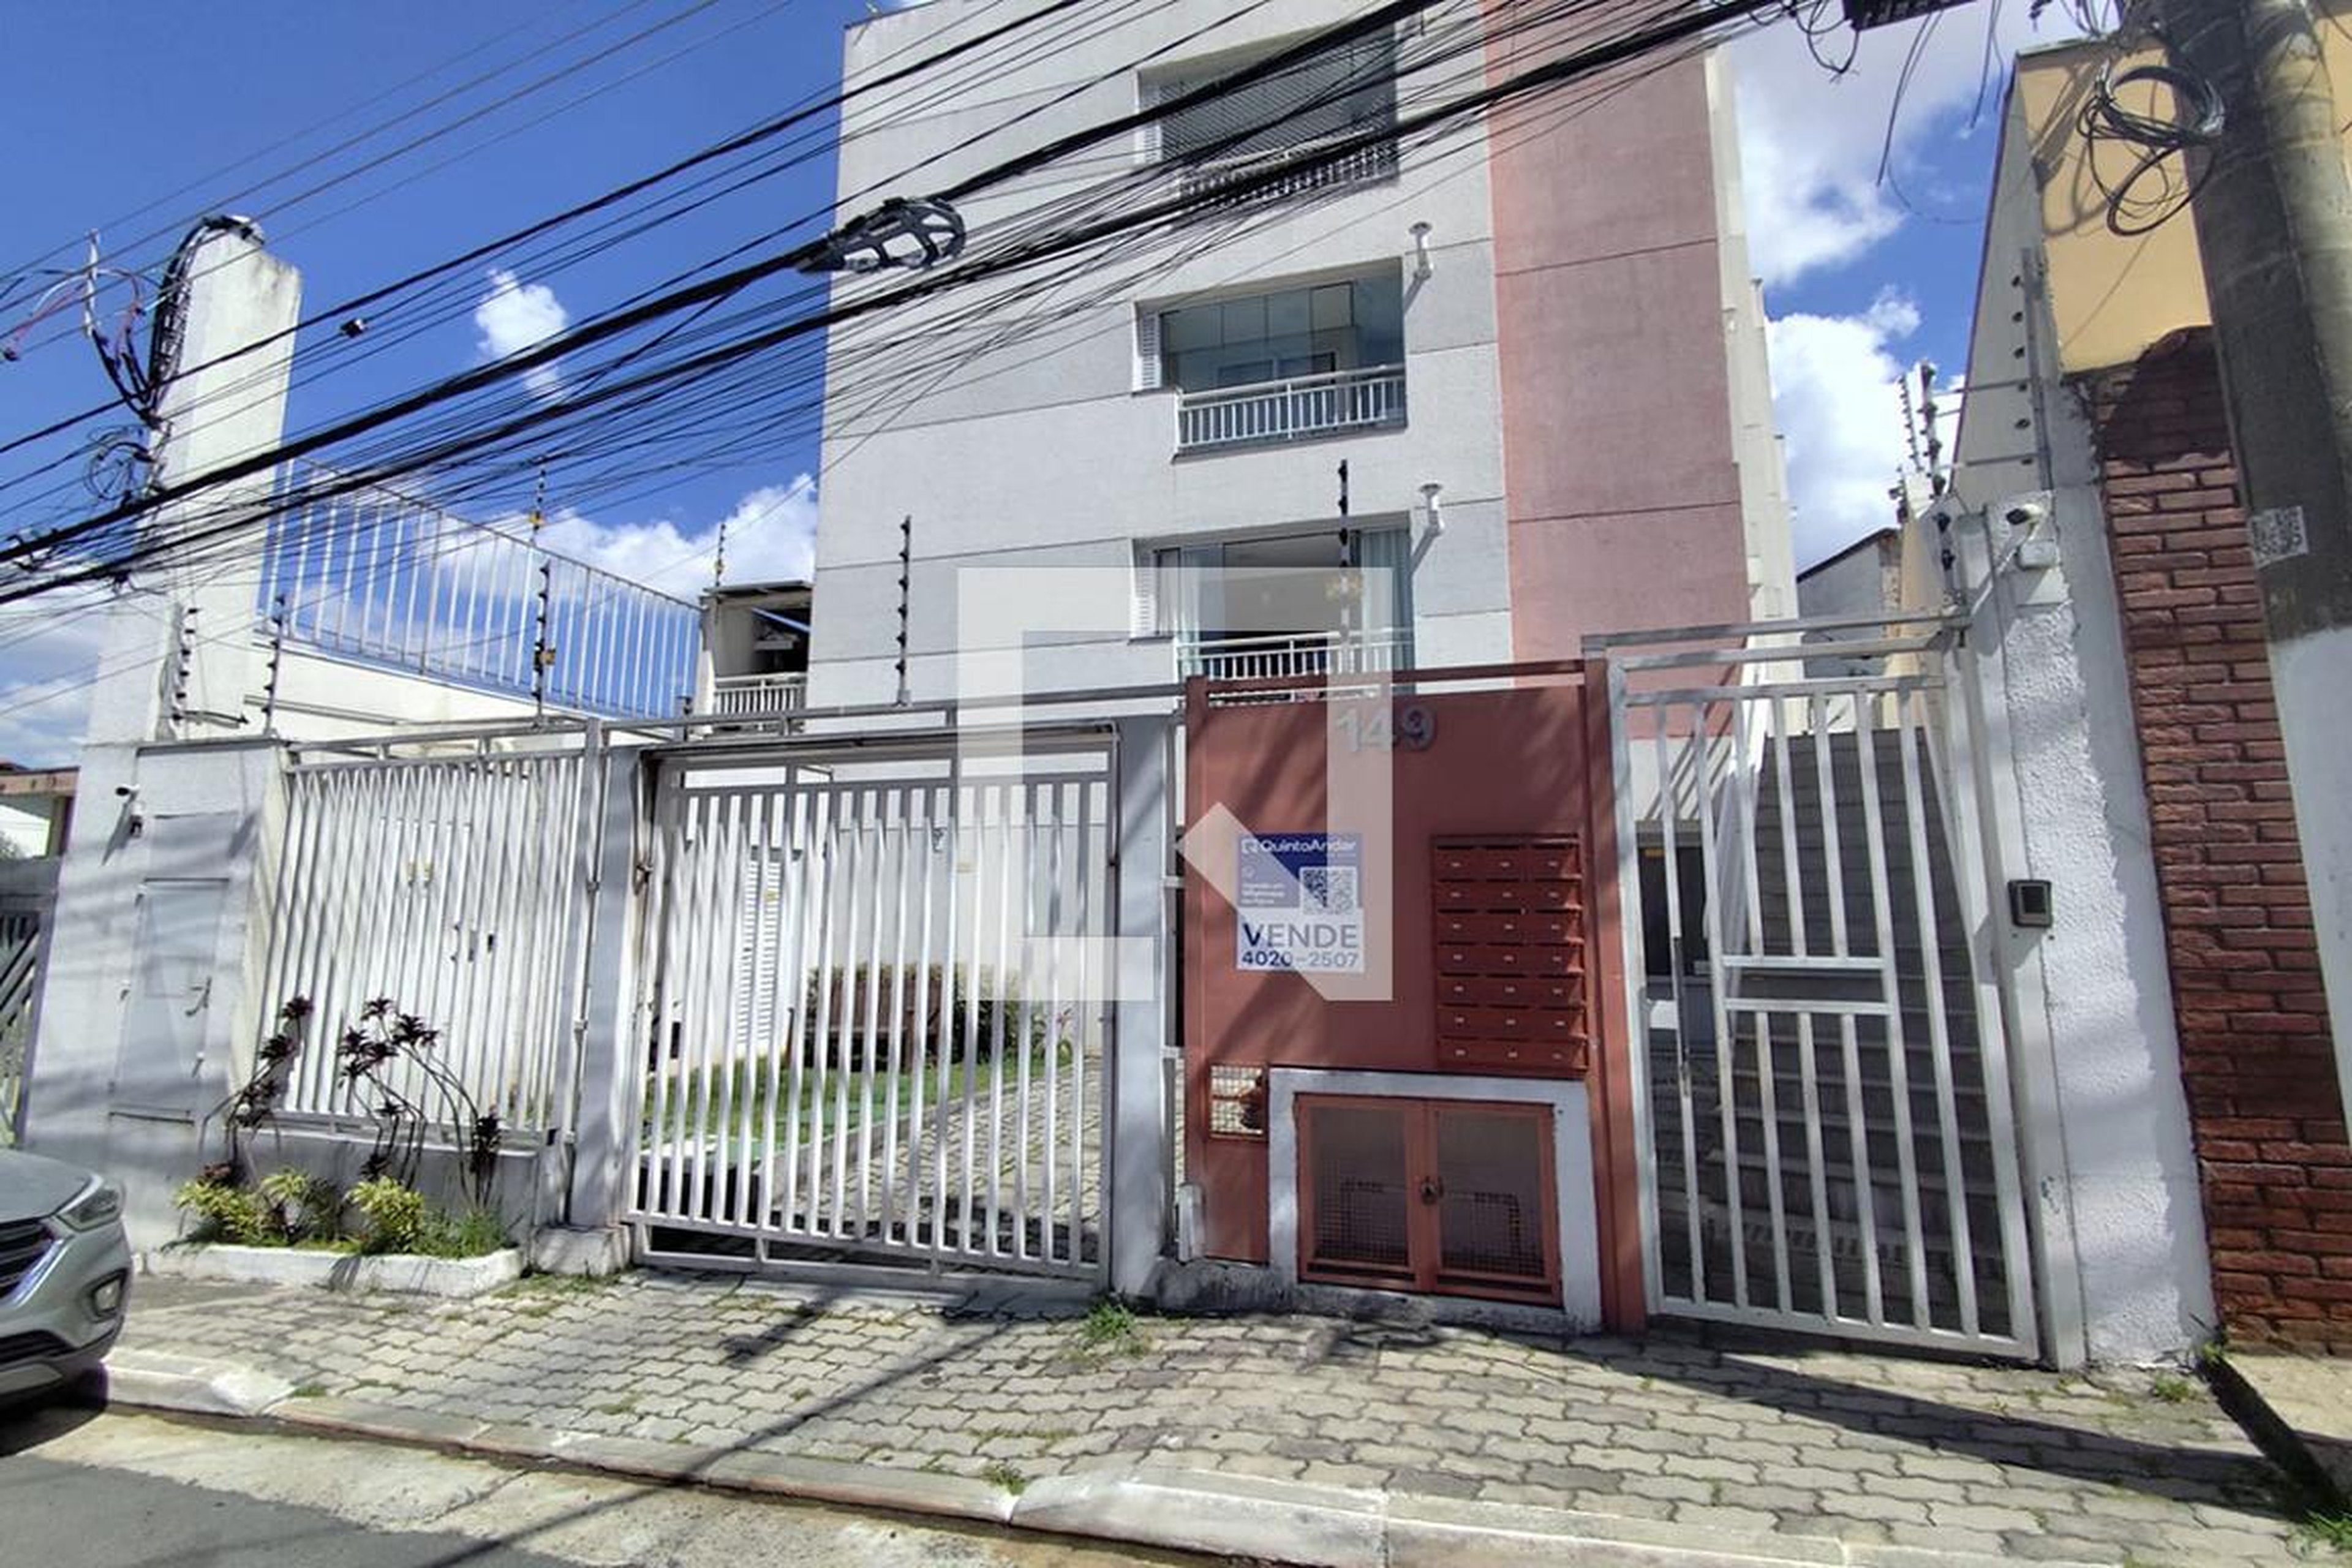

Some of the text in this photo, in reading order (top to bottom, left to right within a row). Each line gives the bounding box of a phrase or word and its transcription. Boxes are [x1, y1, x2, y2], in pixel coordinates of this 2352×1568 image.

[1336, 706, 1436, 752] 149
[1243, 923, 1358, 948] VENDE
[1242, 951, 1359, 968] 4020-2507
